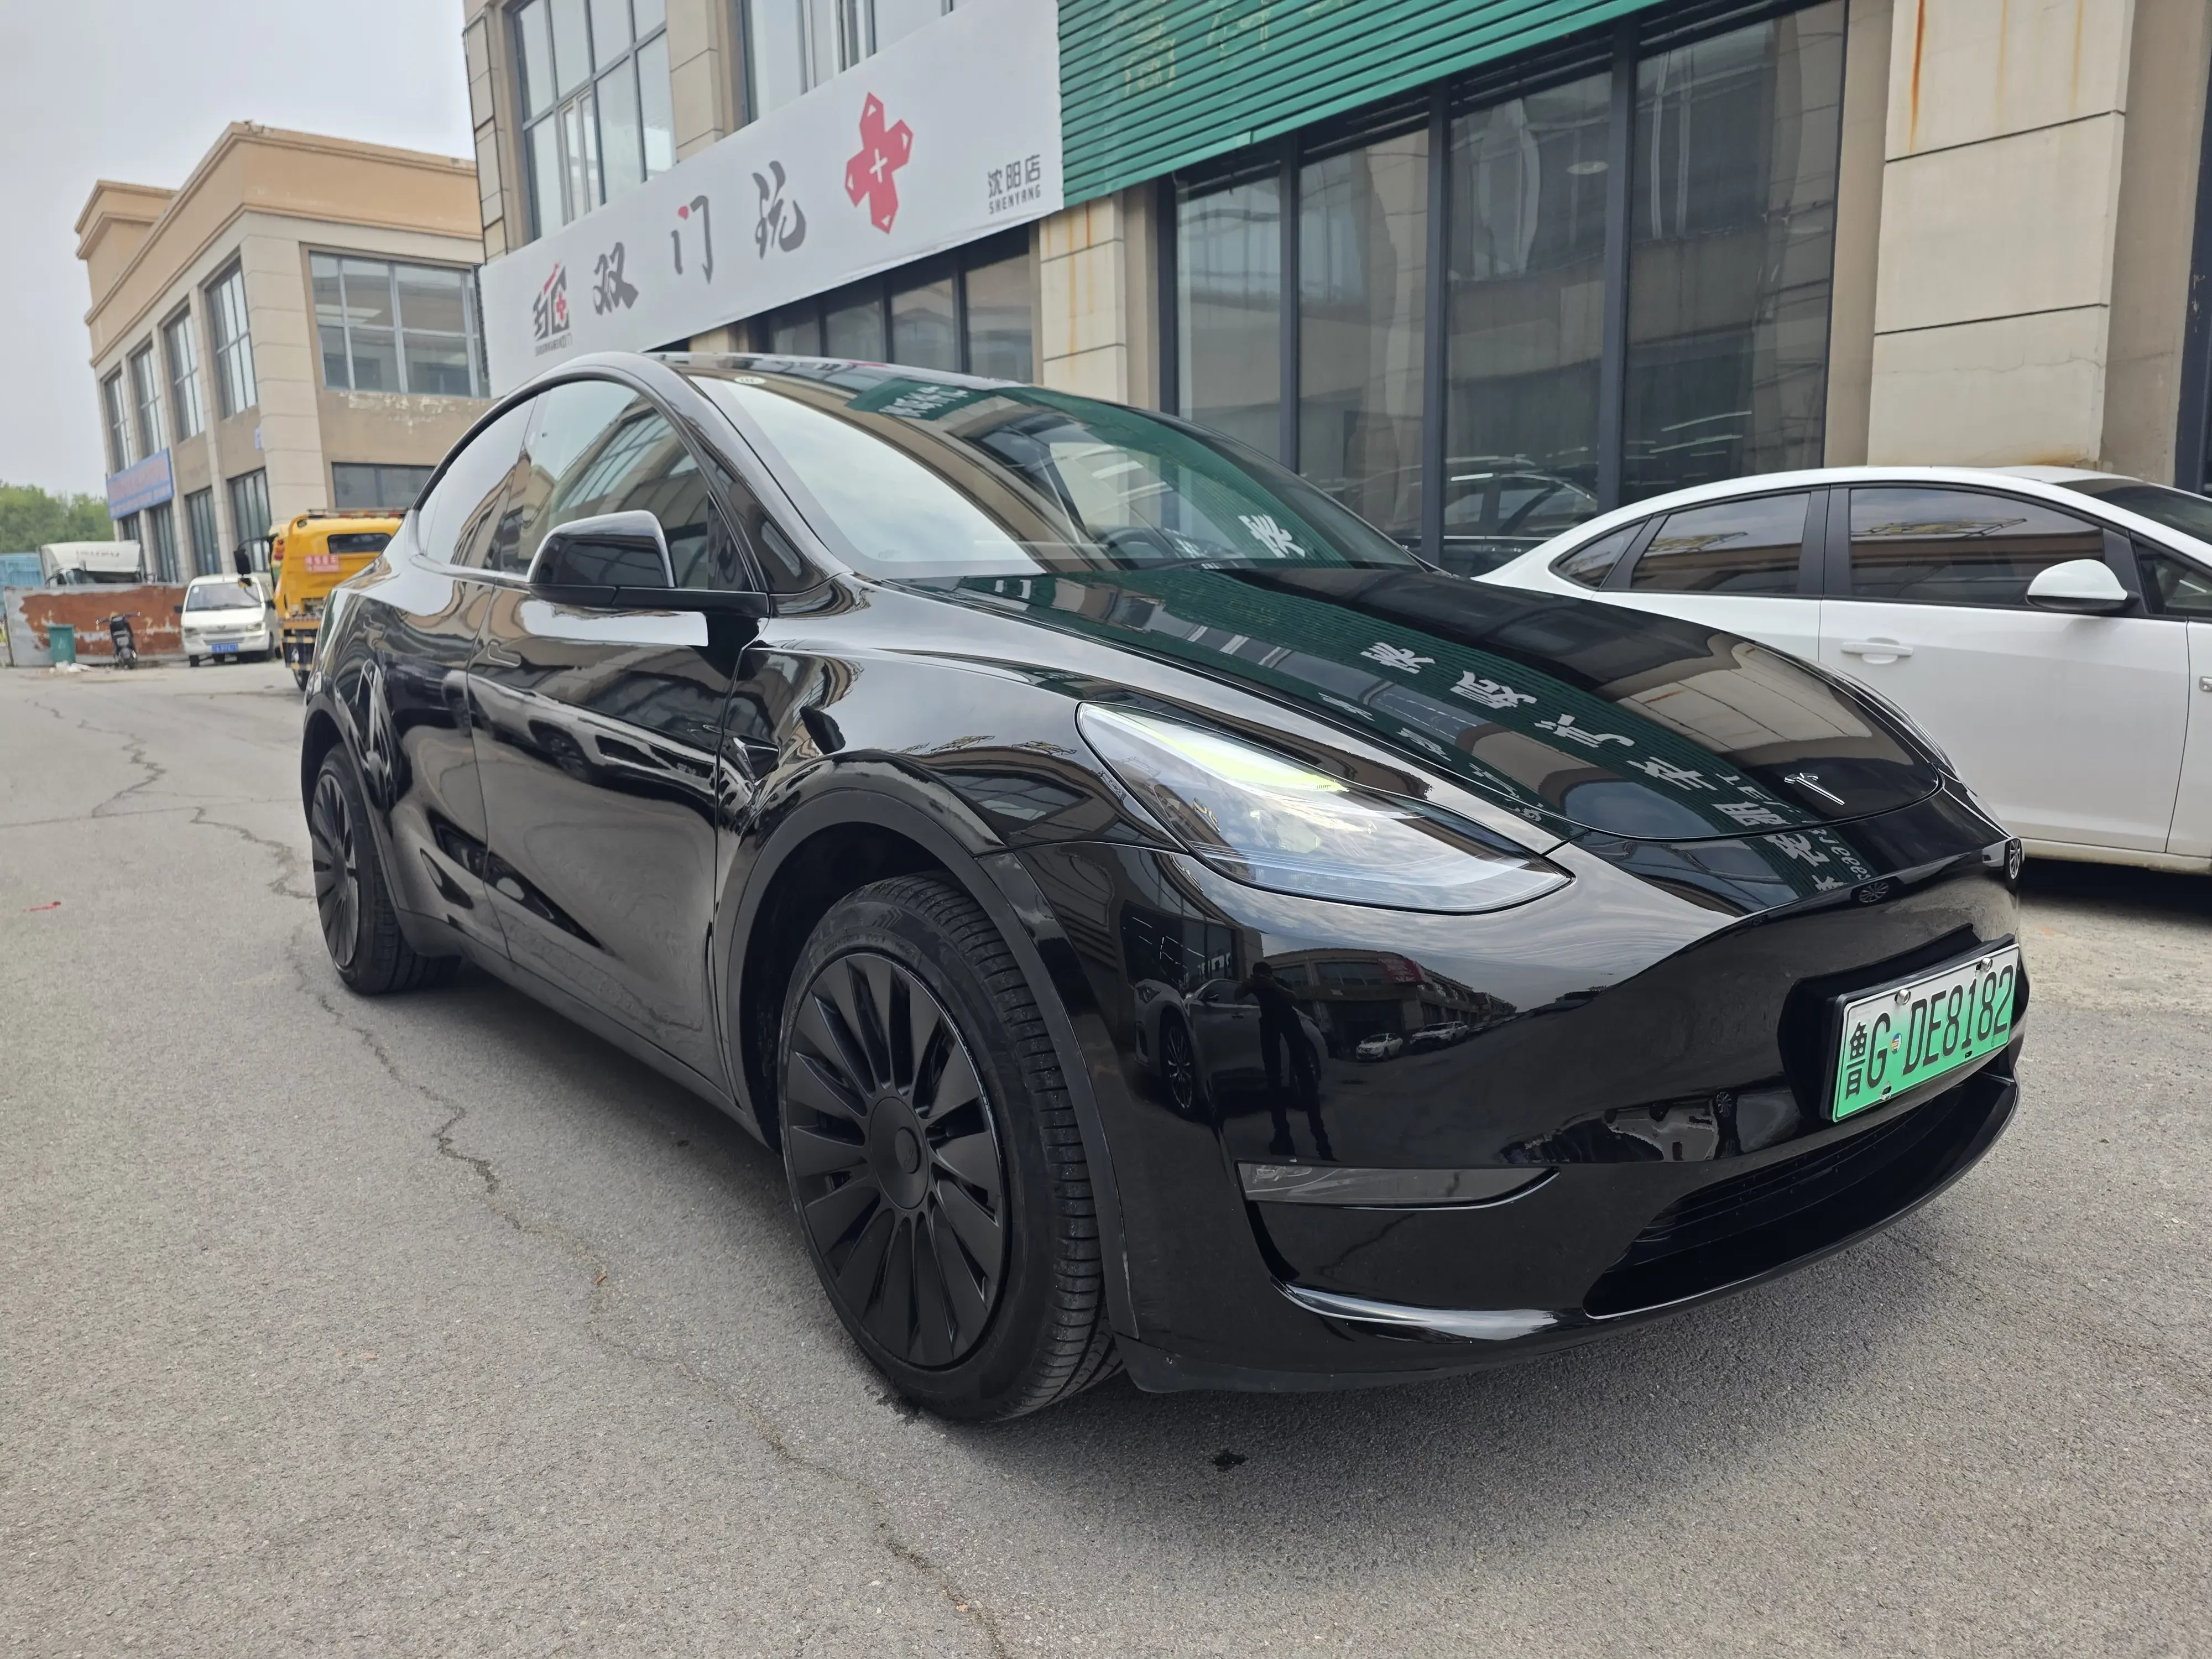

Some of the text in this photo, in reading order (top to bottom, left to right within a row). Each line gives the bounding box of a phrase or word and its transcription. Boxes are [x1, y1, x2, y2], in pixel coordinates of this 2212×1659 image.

[988, 154, 1040, 199] 沈阳店
[989, 184, 1041, 215] SHENYANG
